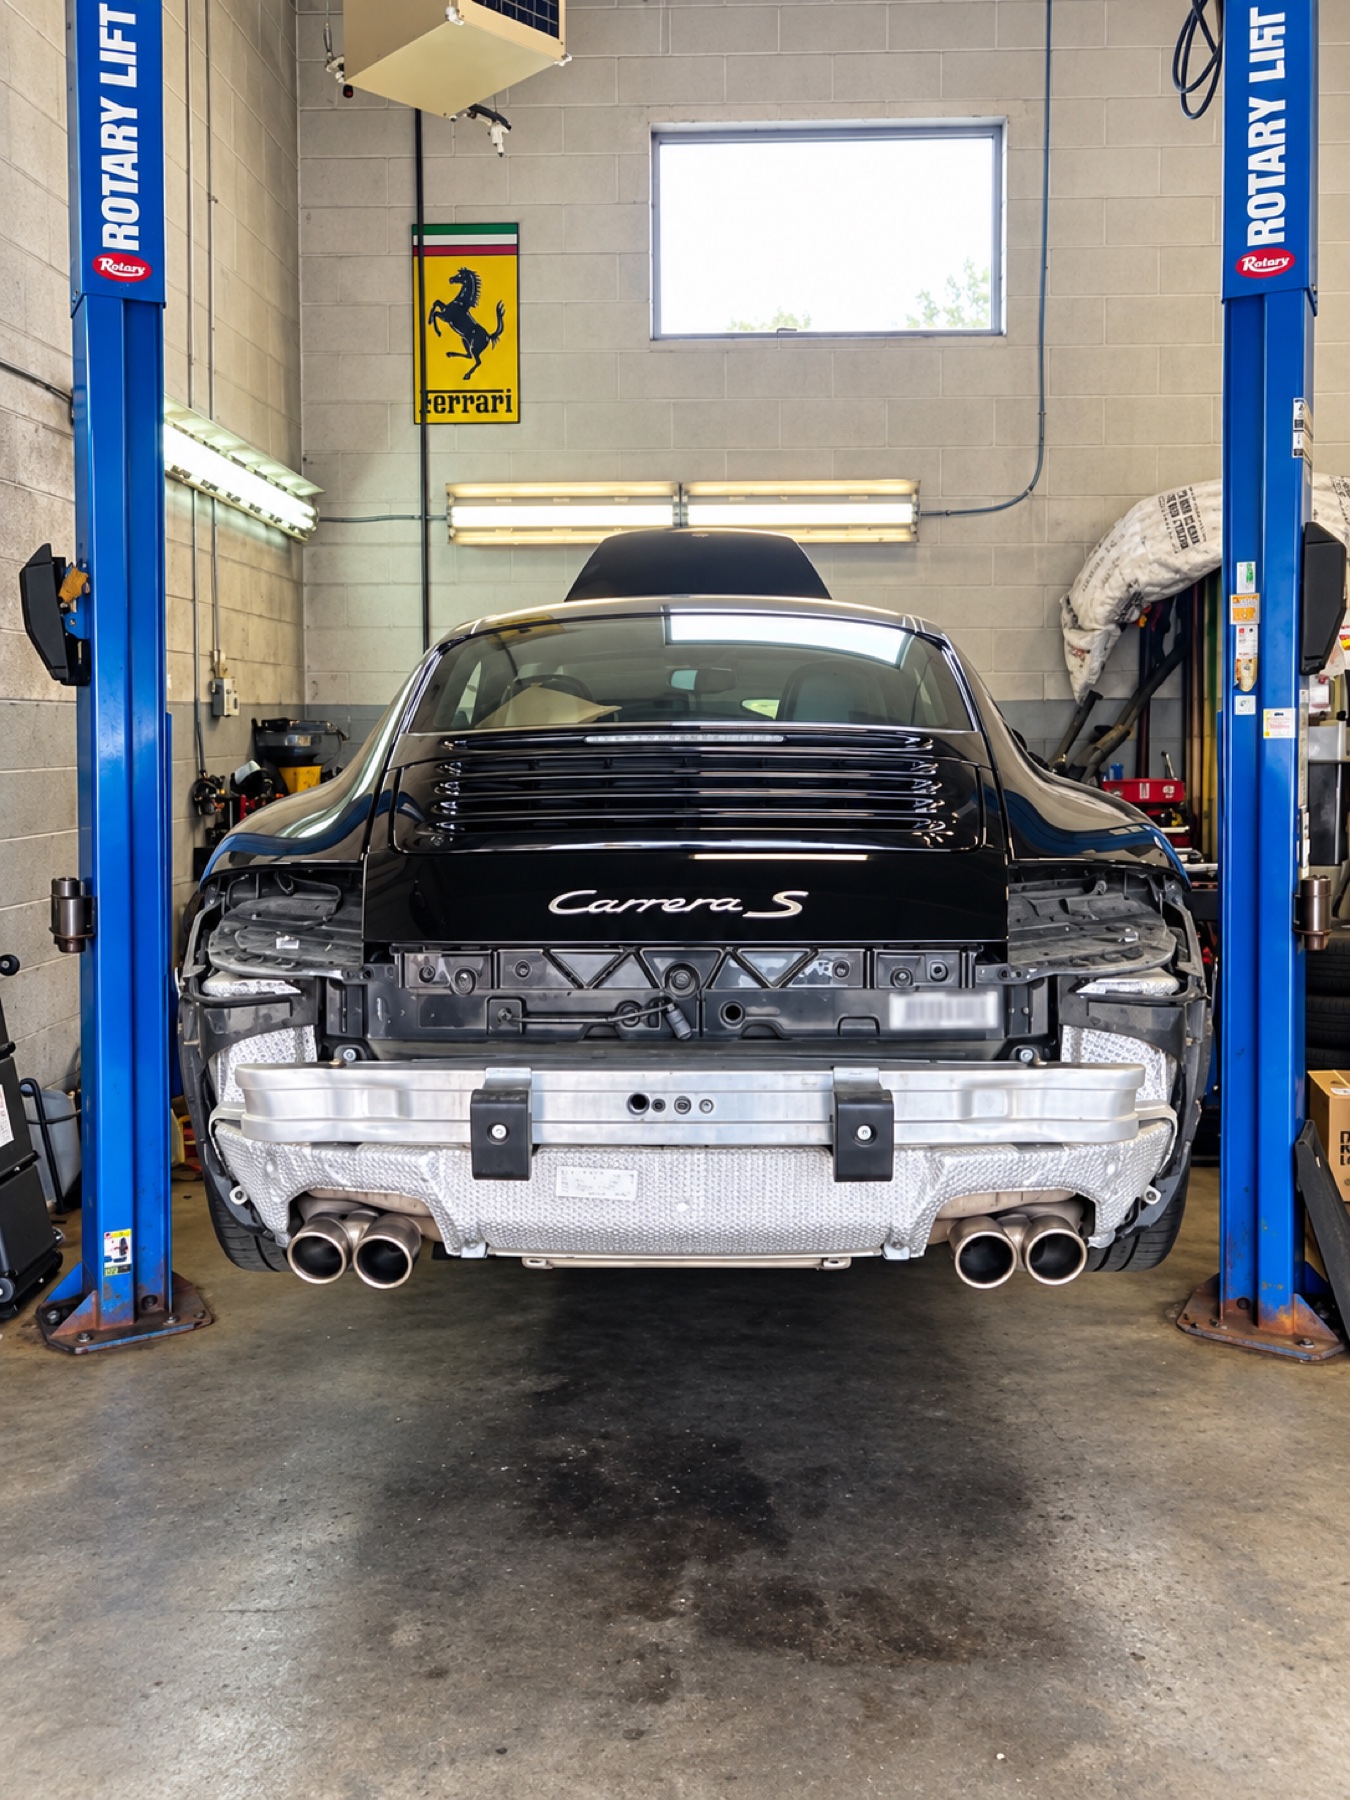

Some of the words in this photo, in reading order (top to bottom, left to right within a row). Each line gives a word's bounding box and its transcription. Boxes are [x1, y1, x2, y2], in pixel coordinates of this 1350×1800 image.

[99, 2, 138, 88] LIFT
[100, 96, 140, 251] ROTARY
[1246, 96, 1286, 247] ROTARY
[97, 257, 146, 277] Rotary
[1241, 255, 1290, 272] Rotary
[548, 889, 744, 915] Carrera
[742, 890, 809, 918] S
